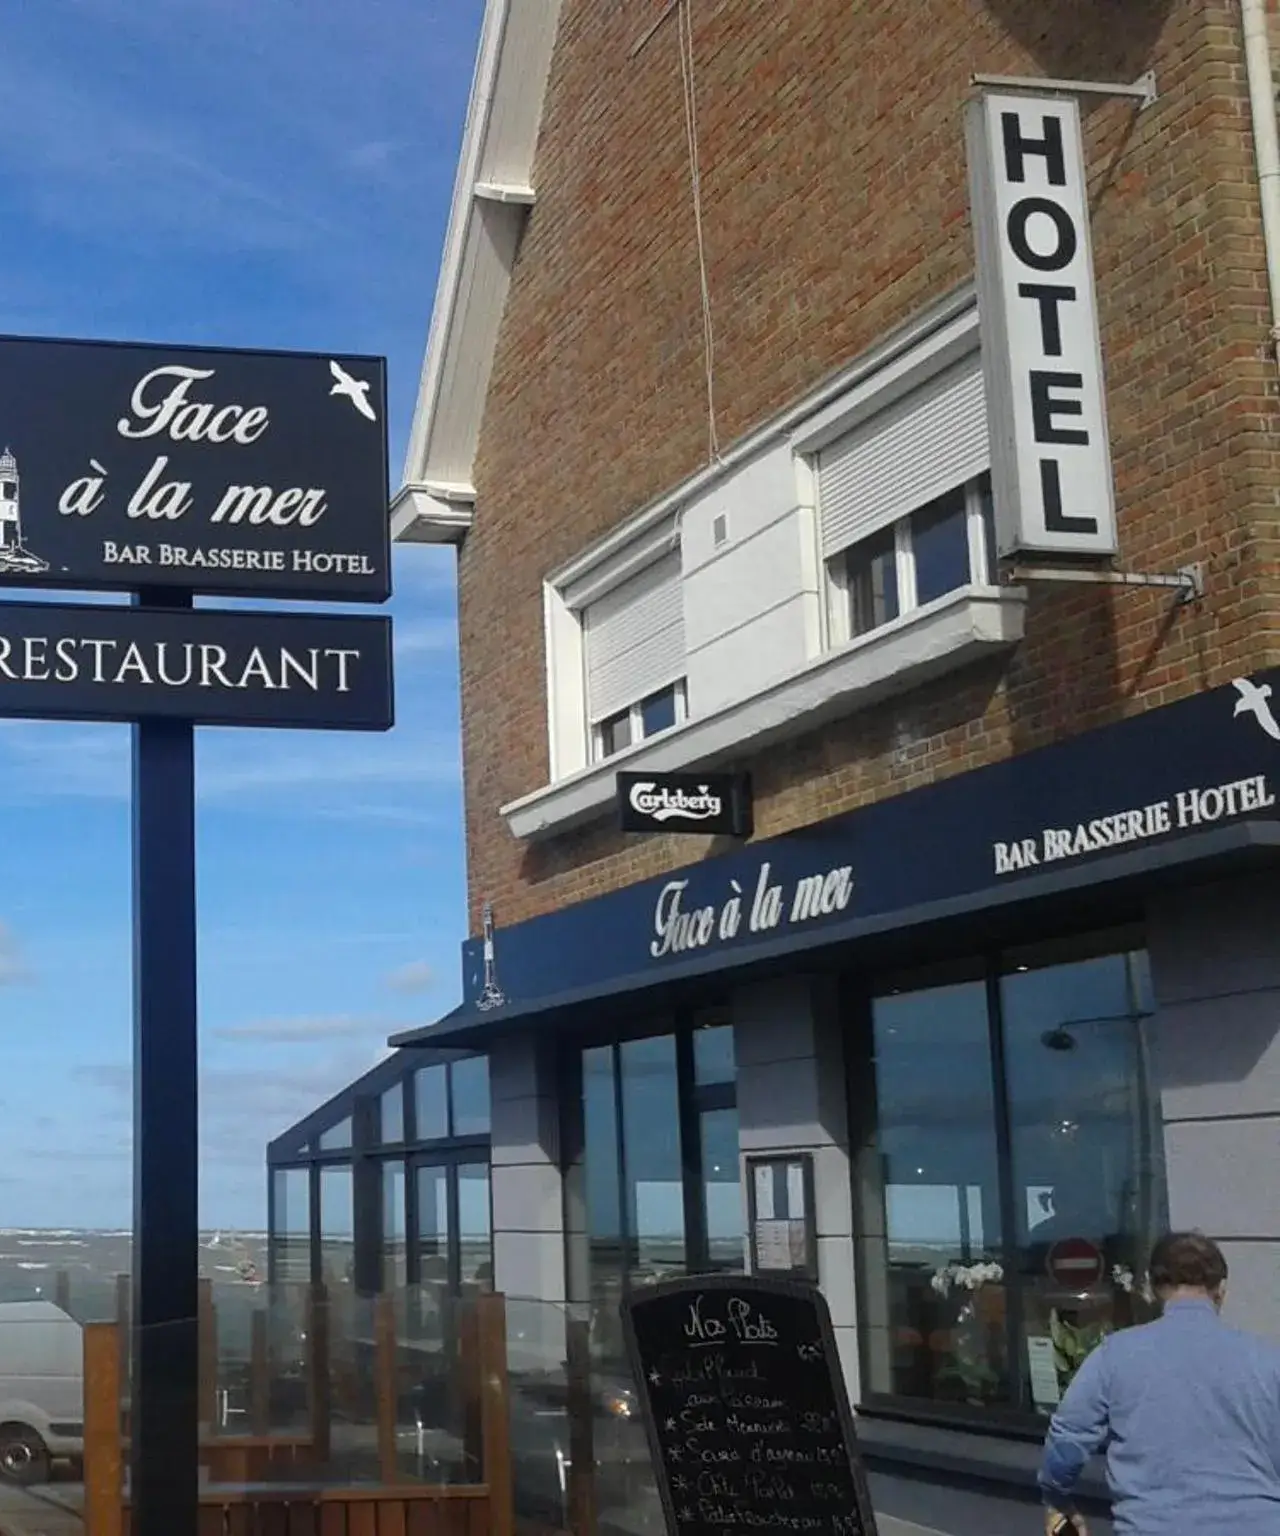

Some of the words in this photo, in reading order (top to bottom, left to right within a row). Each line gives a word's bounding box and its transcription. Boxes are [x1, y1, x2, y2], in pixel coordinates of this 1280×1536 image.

[1001, 111, 1098, 534] HOTEL
[117, 365, 269, 444] Face
[58, 459, 109, 516] à
[127, 456, 193, 520] la
[210, 483, 328, 527] mer
[103, 541, 153, 565] BAR
[159, 543, 286, 571] BRASSERIE
[292, 550, 376, 575] HOTEL
[629, 782, 721, 818] Carlsberg
[993, 841, 1040, 875] BAR
[1043, 800, 1172, 862] BRASSERIE
[1175, 774, 1276, 828] HOTEL
[650, 879, 715, 957] Face
[719, 879, 742, 940] à
[749, 862, 784, 932] la
[789, 865, 854, 922] mer
